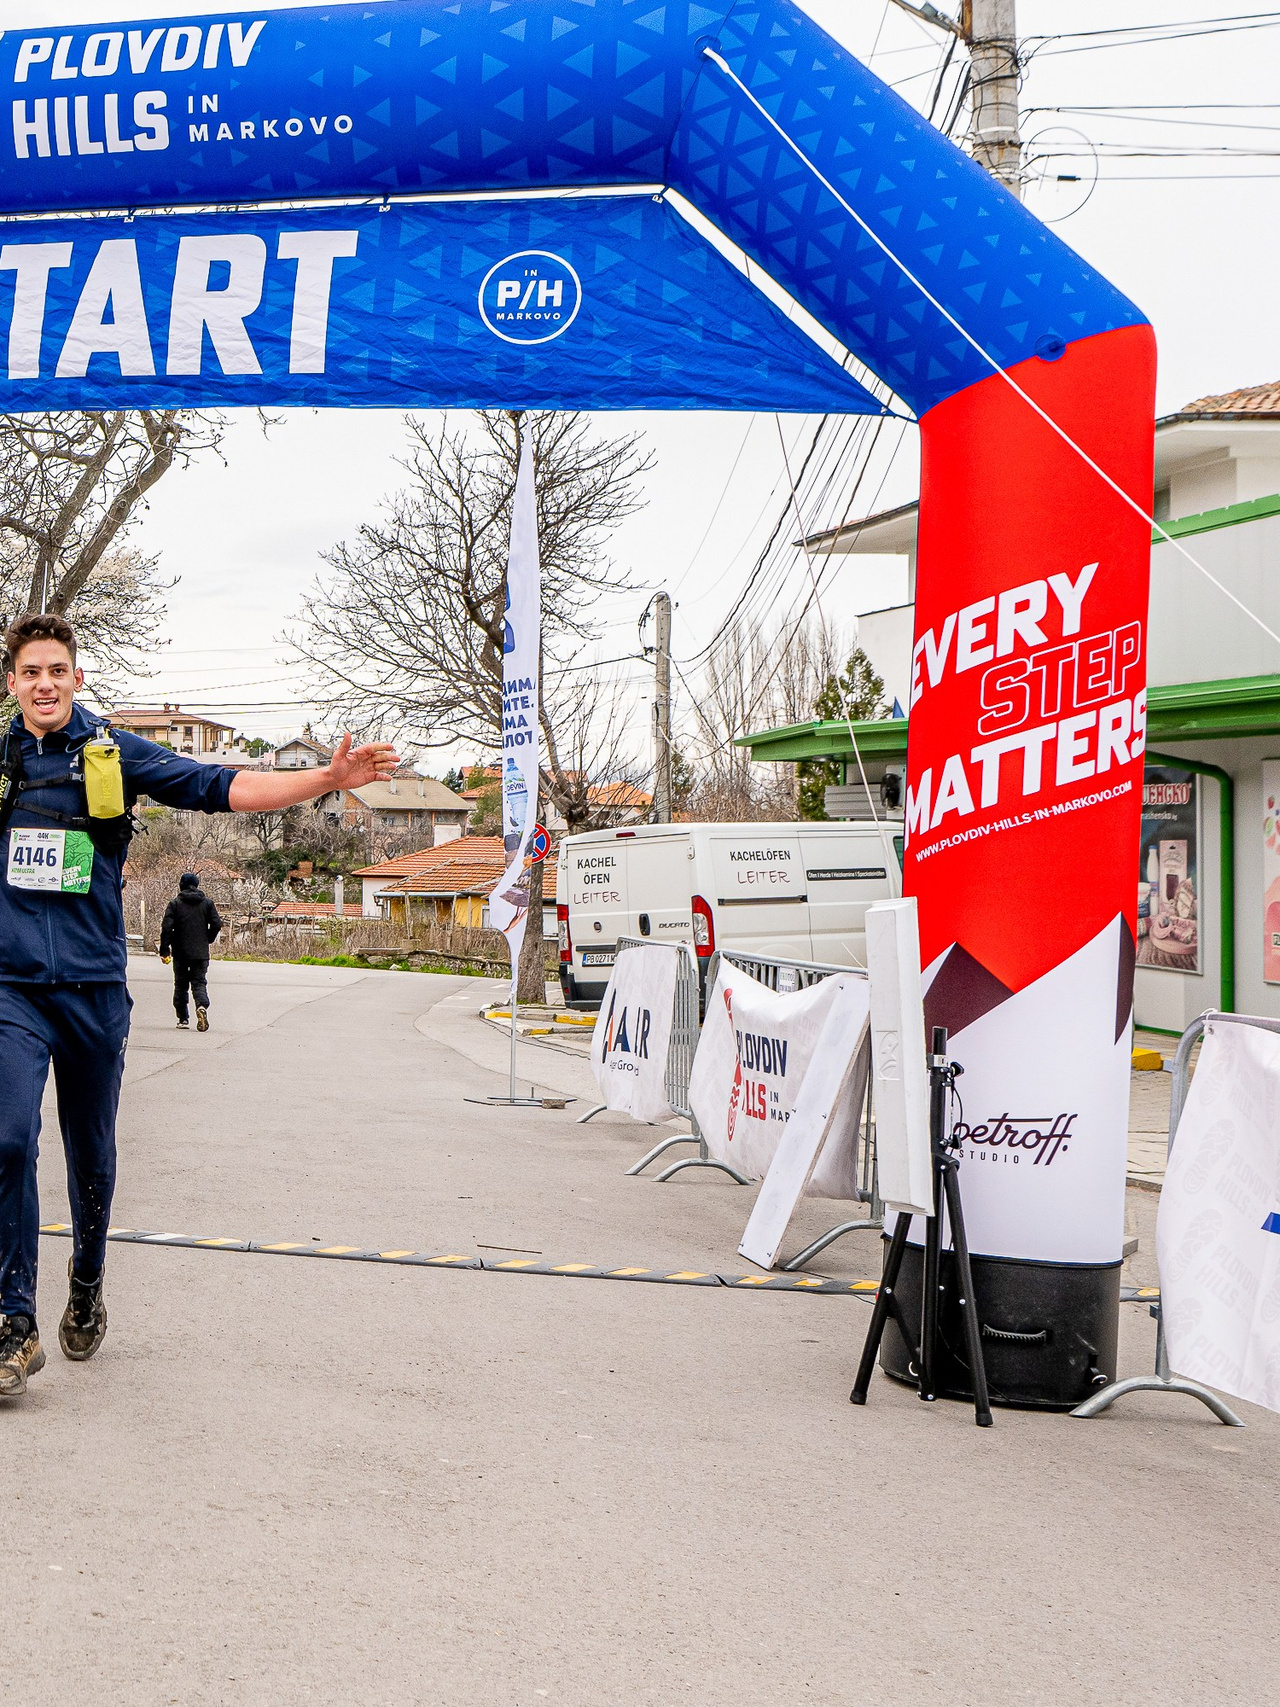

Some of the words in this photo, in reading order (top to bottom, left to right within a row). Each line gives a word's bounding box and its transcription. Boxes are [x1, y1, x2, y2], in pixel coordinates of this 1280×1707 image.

[14, 20, 267, 84] PLOVDIV
[187, 94, 219, 115] IN
[12, 90, 170, 159] HILLS
[189, 115, 354, 142] MARKOVO
[524, 269, 538, 277] IN
[497, 279, 563, 310] P/H
[496, 312, 561, 321] MARKOVO
[910, 562, 1099, 711] EVERY
[977, 620, 1141, 736] STEP
[904, 688, 1147, 851] MATTERS
[507, 782, 524, 792] DEVIN
[916, 780, 1133, 862] WWW.PLOVDIV-HILLS-IN-MARKOVO.COM
[13, 847, 57, 867] 4146
[577, 857, 617, 869] KACHEL
[730, 848, 791, 861] KACHELÖFEN
[583, 872, 611, 885] ÖFEN
[737, 870, 790, 884] LEITER
[573, 891, 621, 905] LEITER
[770, 1091, 779, 1103] IN
[958, 1149, 1020, 1164] STUDIO
